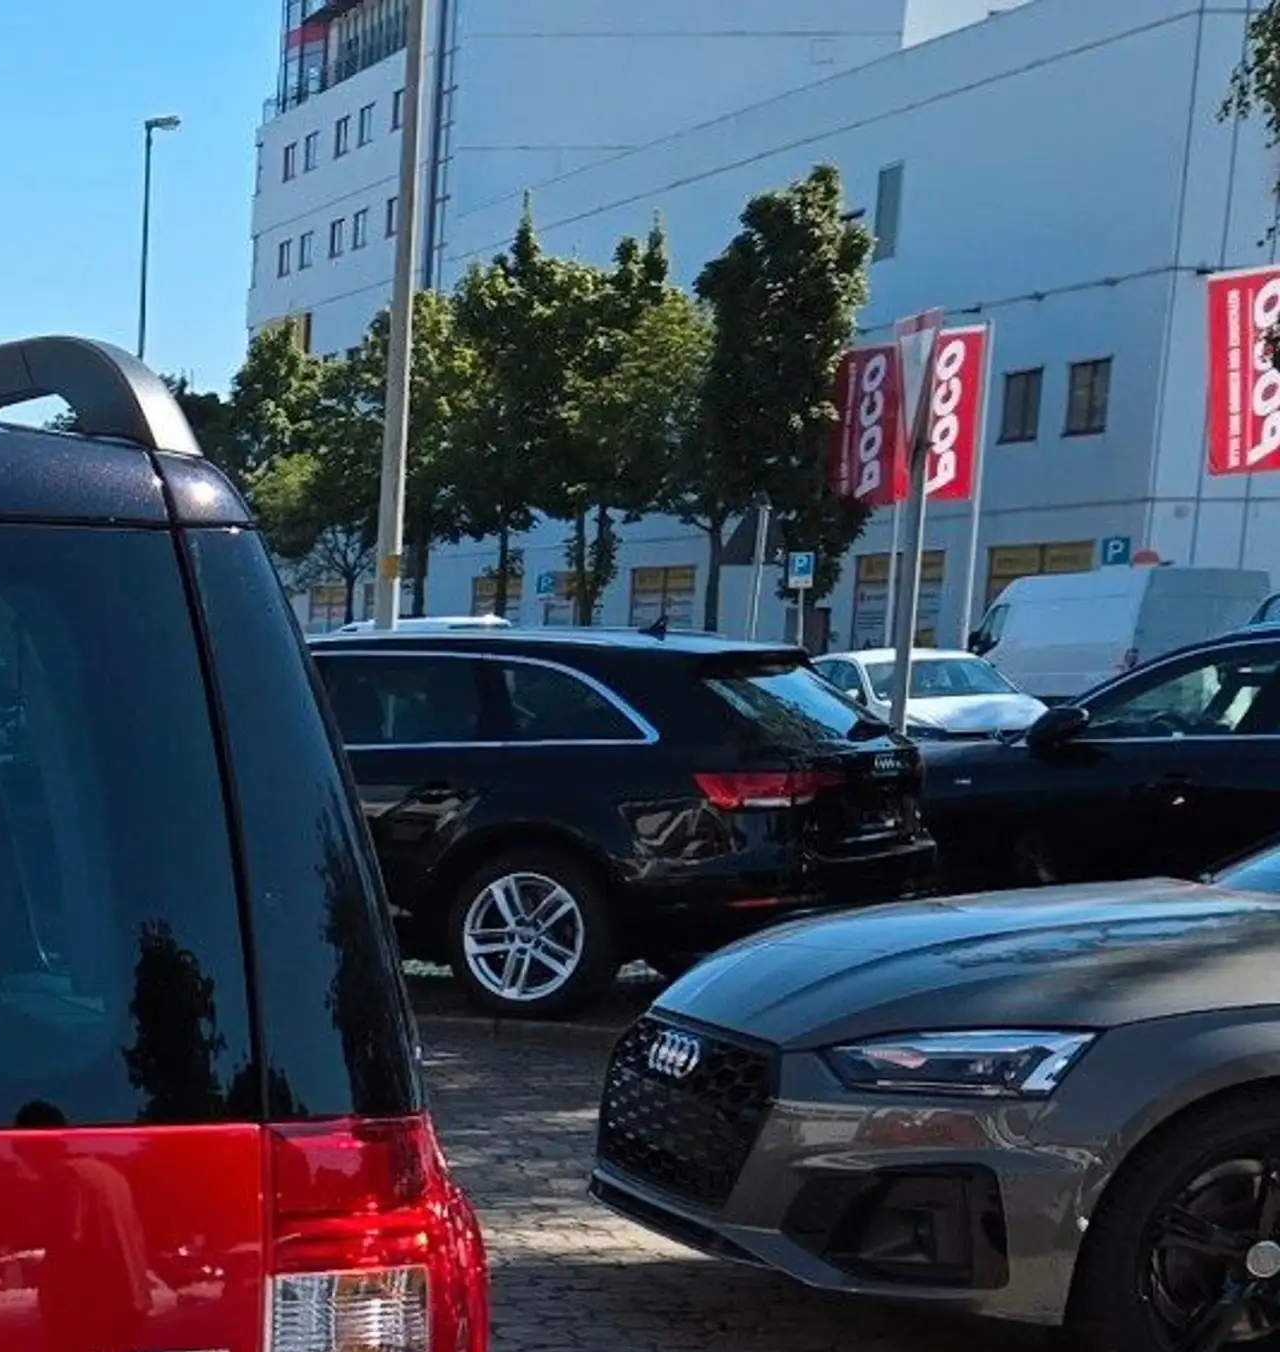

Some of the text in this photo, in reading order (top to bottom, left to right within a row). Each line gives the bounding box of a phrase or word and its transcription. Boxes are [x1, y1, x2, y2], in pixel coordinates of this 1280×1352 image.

[853, 353, 887, 498] poco
[925, 339, 966, 495] poco
[1107, 540, 1124, 563] P
